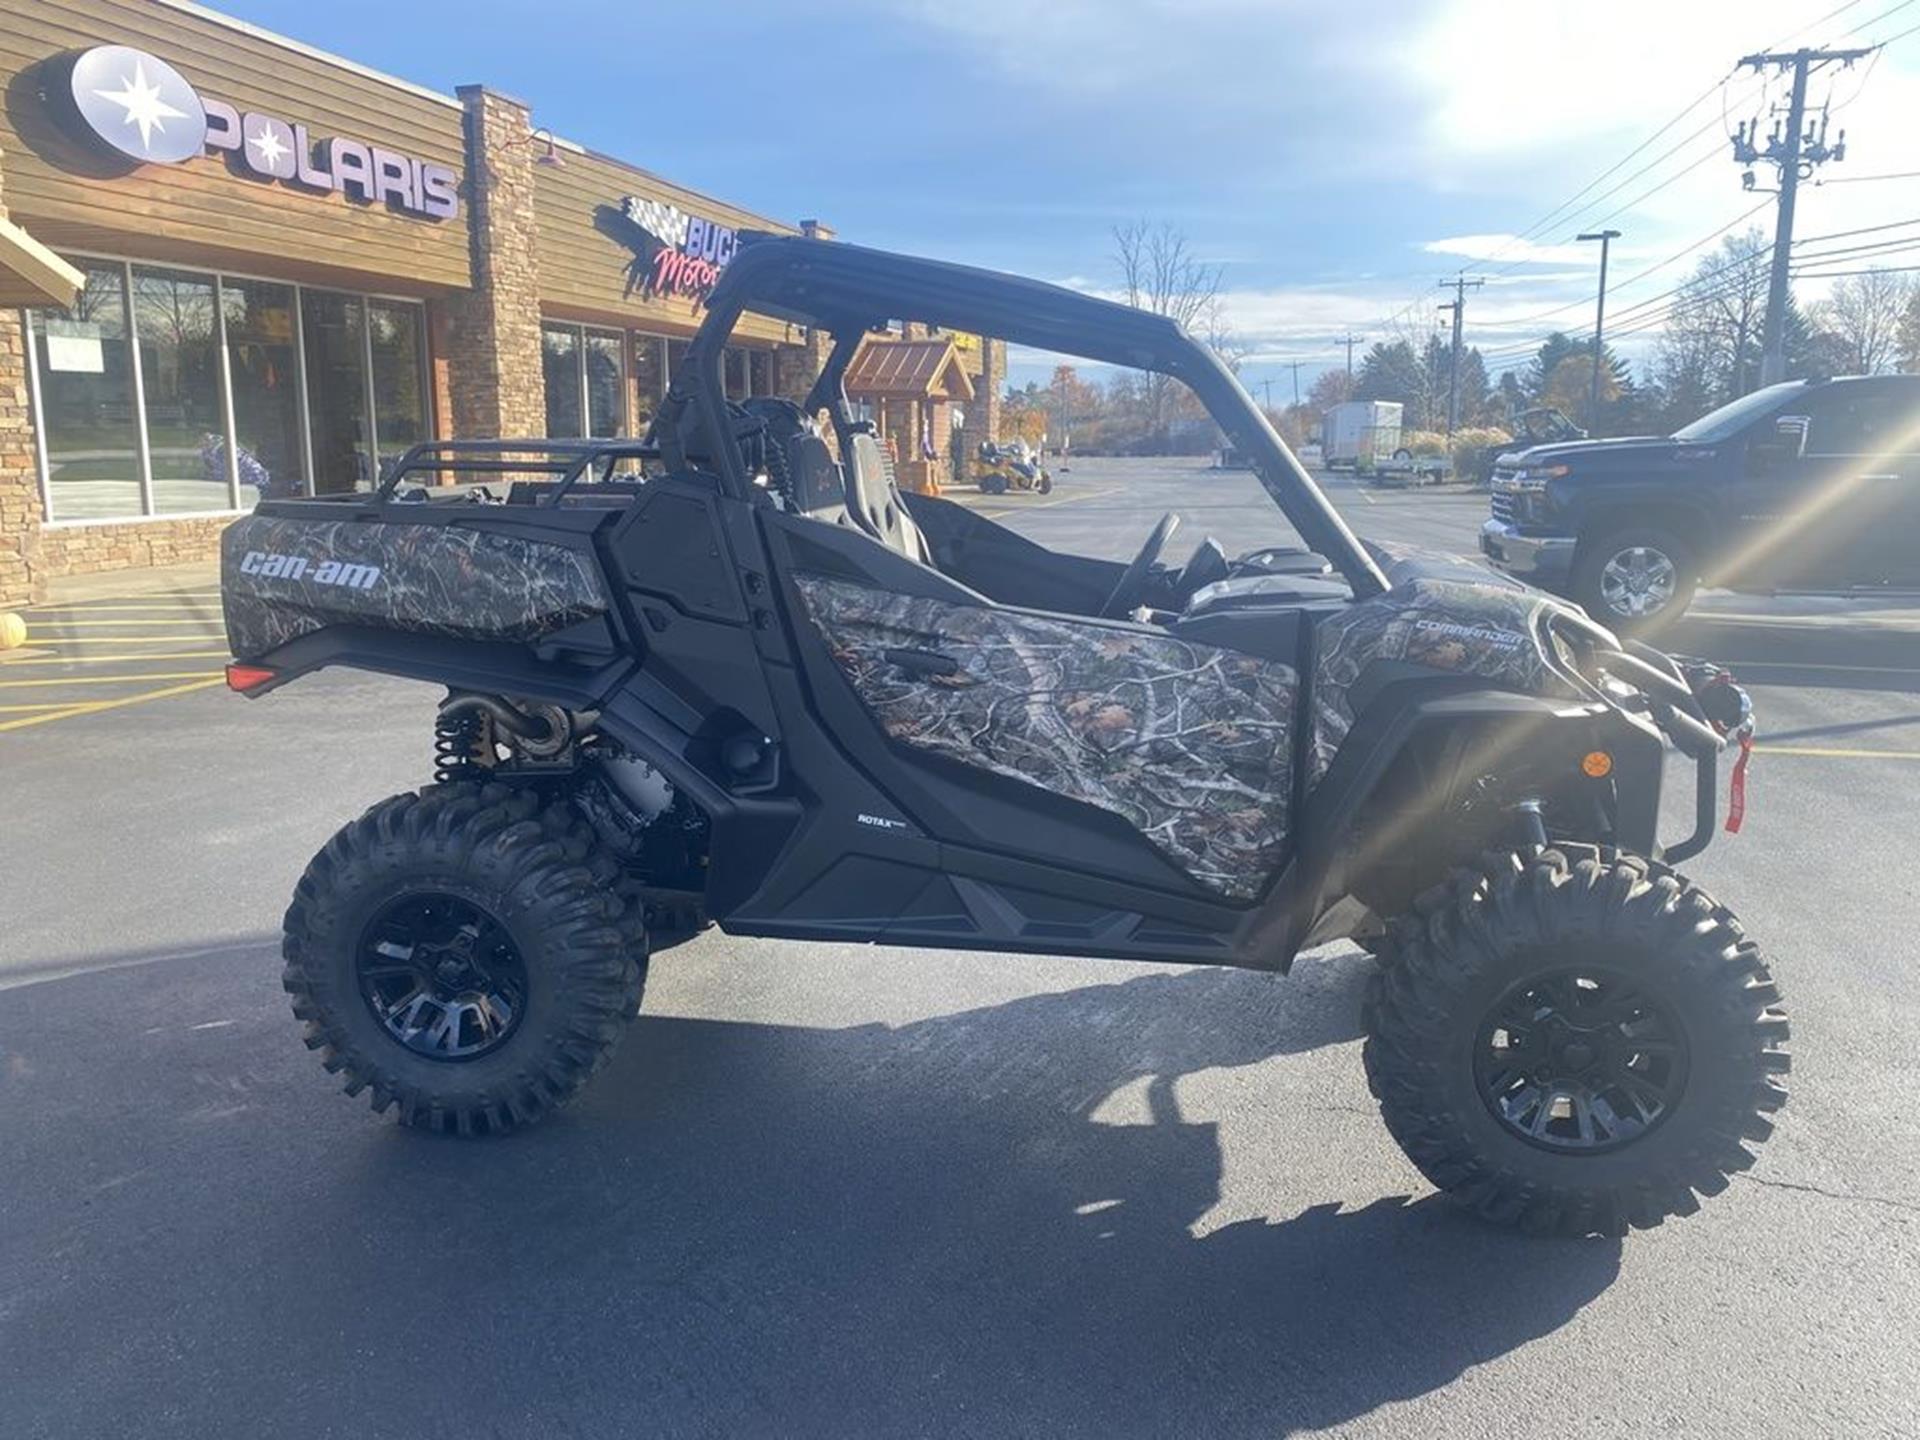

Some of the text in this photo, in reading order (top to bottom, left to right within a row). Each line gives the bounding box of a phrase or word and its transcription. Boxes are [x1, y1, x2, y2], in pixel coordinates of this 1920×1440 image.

[200, 96, 459, 219] POLARIS
[240, 551, 381, 589] can-am
[858, 814, 892, 828] ROTAX
